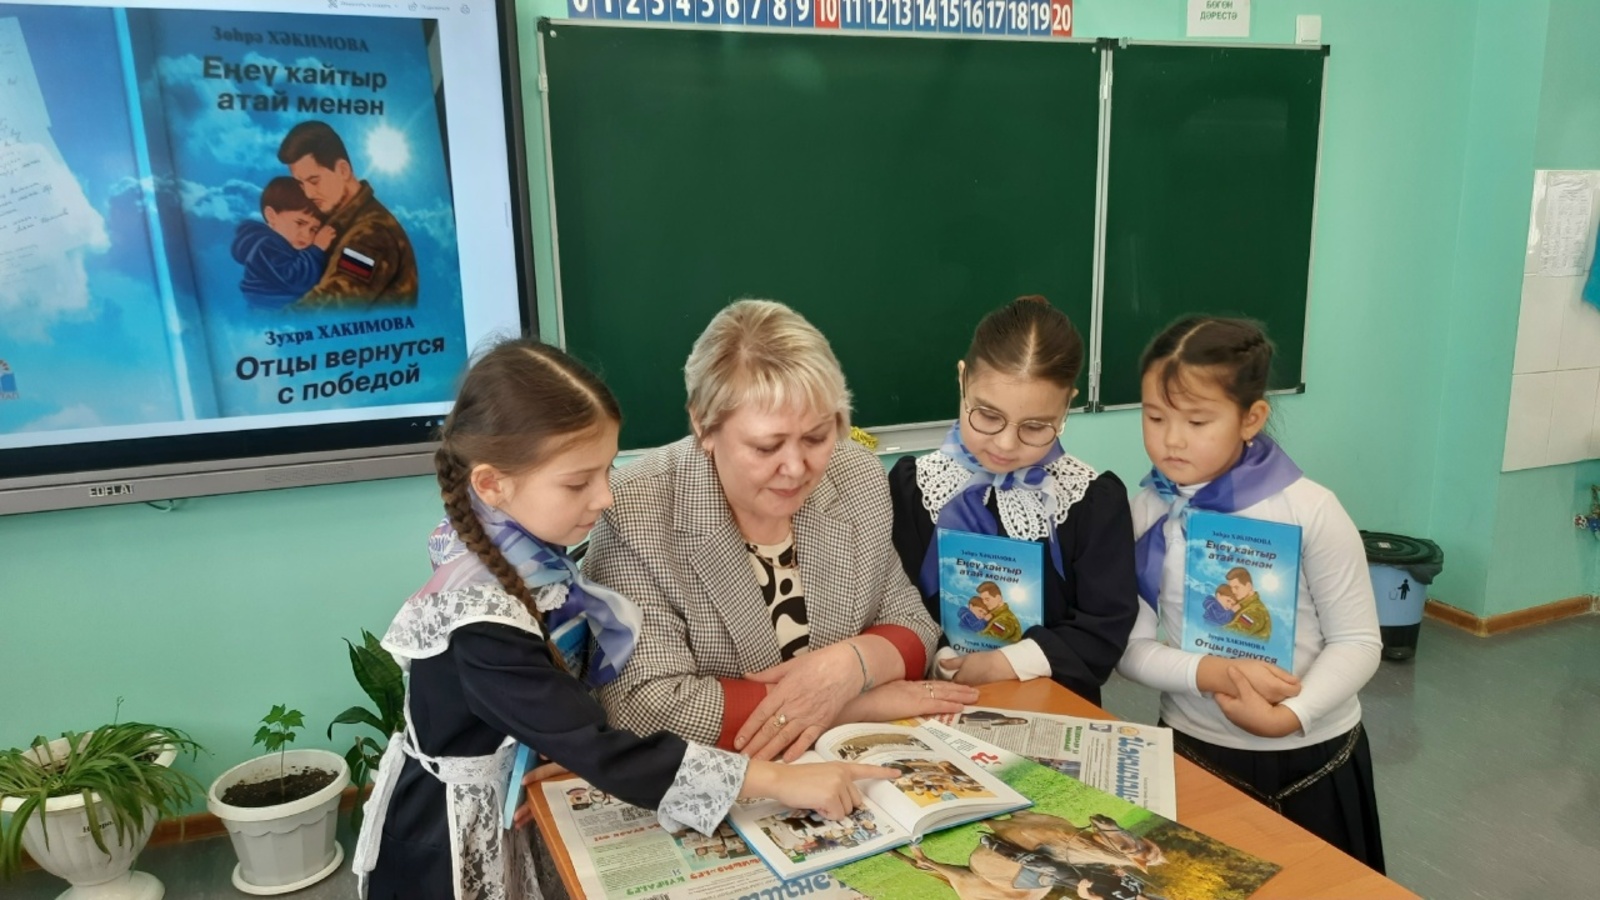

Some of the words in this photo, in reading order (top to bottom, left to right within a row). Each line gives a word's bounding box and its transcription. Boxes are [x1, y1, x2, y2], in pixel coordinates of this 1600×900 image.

[820, 0, 838, 22] 10
[843, 0, 861, 23] 11
[868, 0, 888, 24] 12
[892, 0, 912, 25] 13
[916, 0, 937, 26] 14
[940, 0, 960, 27] 15
[963, 0, 983, 28] 16
[986, 0, 1006, 29] 17
[1008, 1, 1028, 30] 18
[1031, 2, 1050, 30] 19
[1052, 3, 1071, 31] 20
[217, 90, 289, 112] атай
[297, 96, 384, 115] менән
[265, 329, 314, 347] Зухра
[317, 316, 415, 339] ХАКИМОВА
[236, 354, 317, 380] Отцы
[325, 337, 445, 368] вернутся
[278, 386, 294, 404] с
[303, 363, 420, 401] победой
[1195, 638, 1224, 652] Отцы
